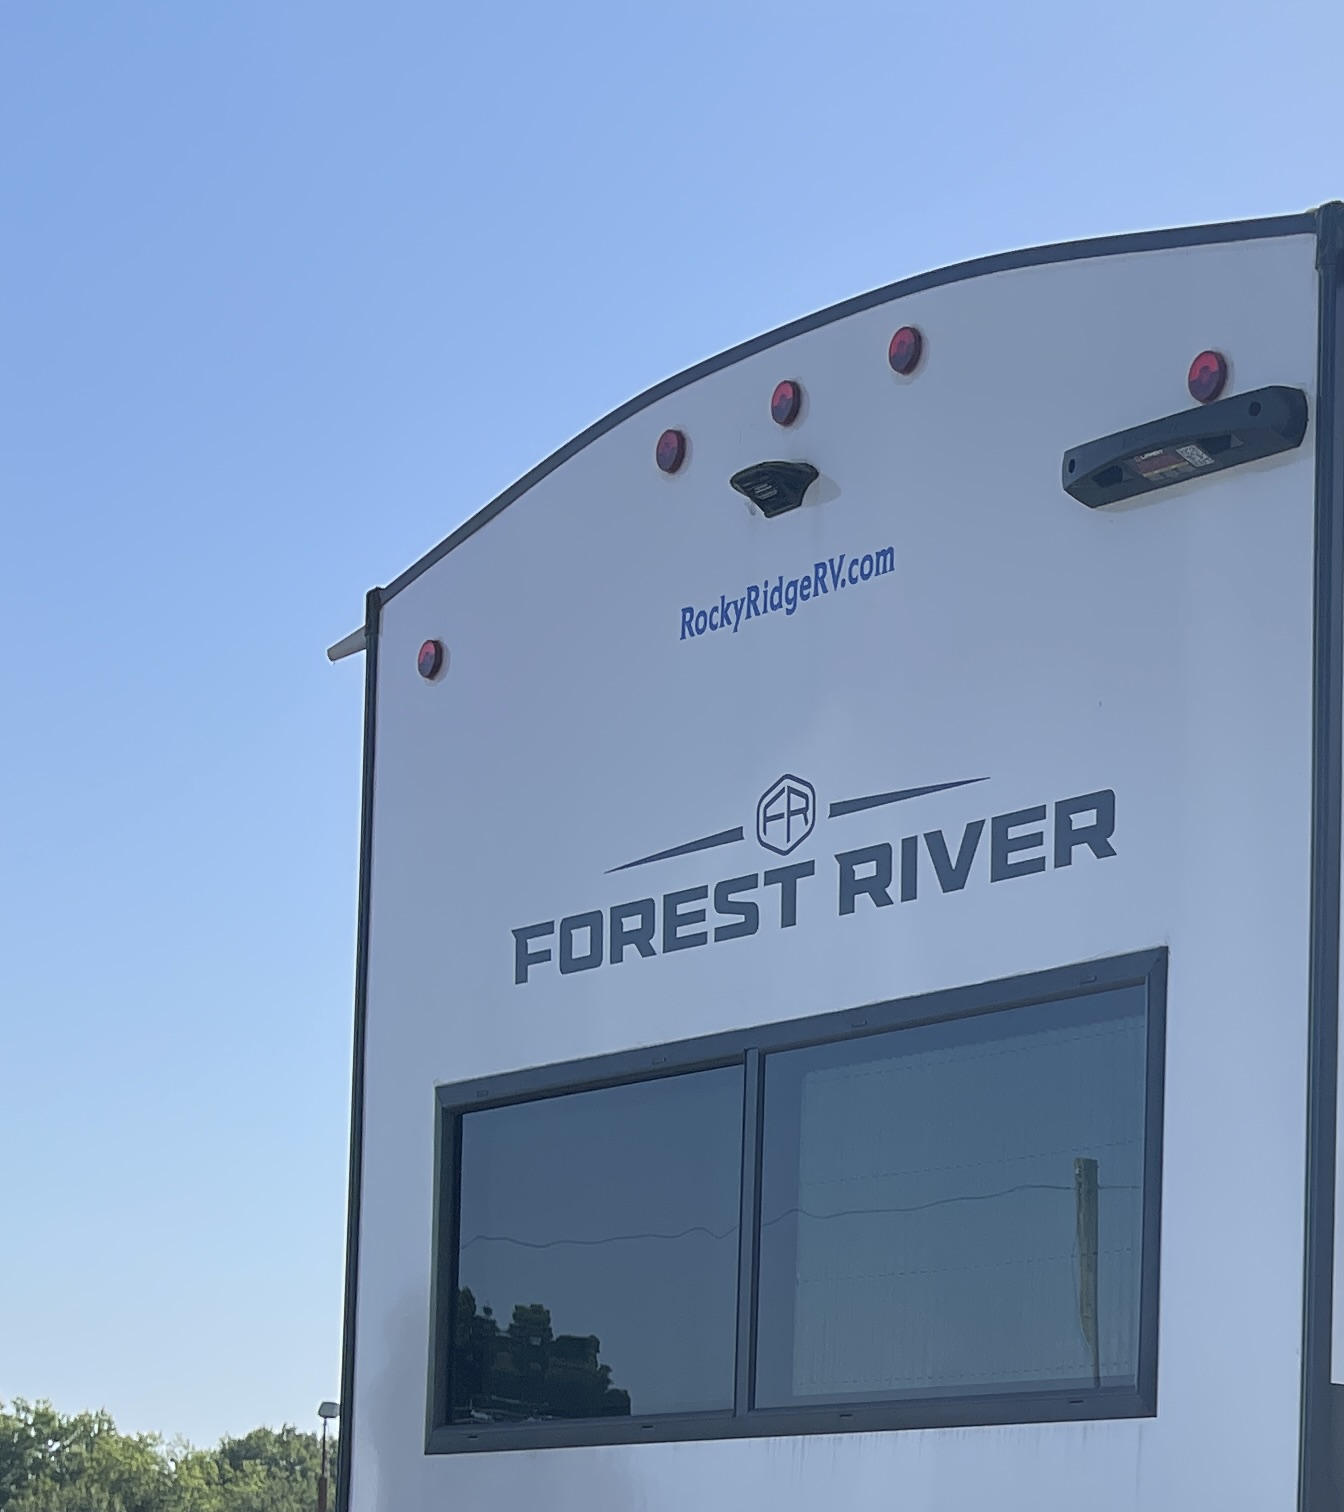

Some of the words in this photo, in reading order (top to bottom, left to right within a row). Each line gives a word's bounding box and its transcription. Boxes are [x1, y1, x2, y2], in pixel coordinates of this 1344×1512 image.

[679, 546, 895, 641] RockyRidgeRV.com
[511, 860, 815, 985] FOREST
[834, 789, 1117, 916] RIVER
